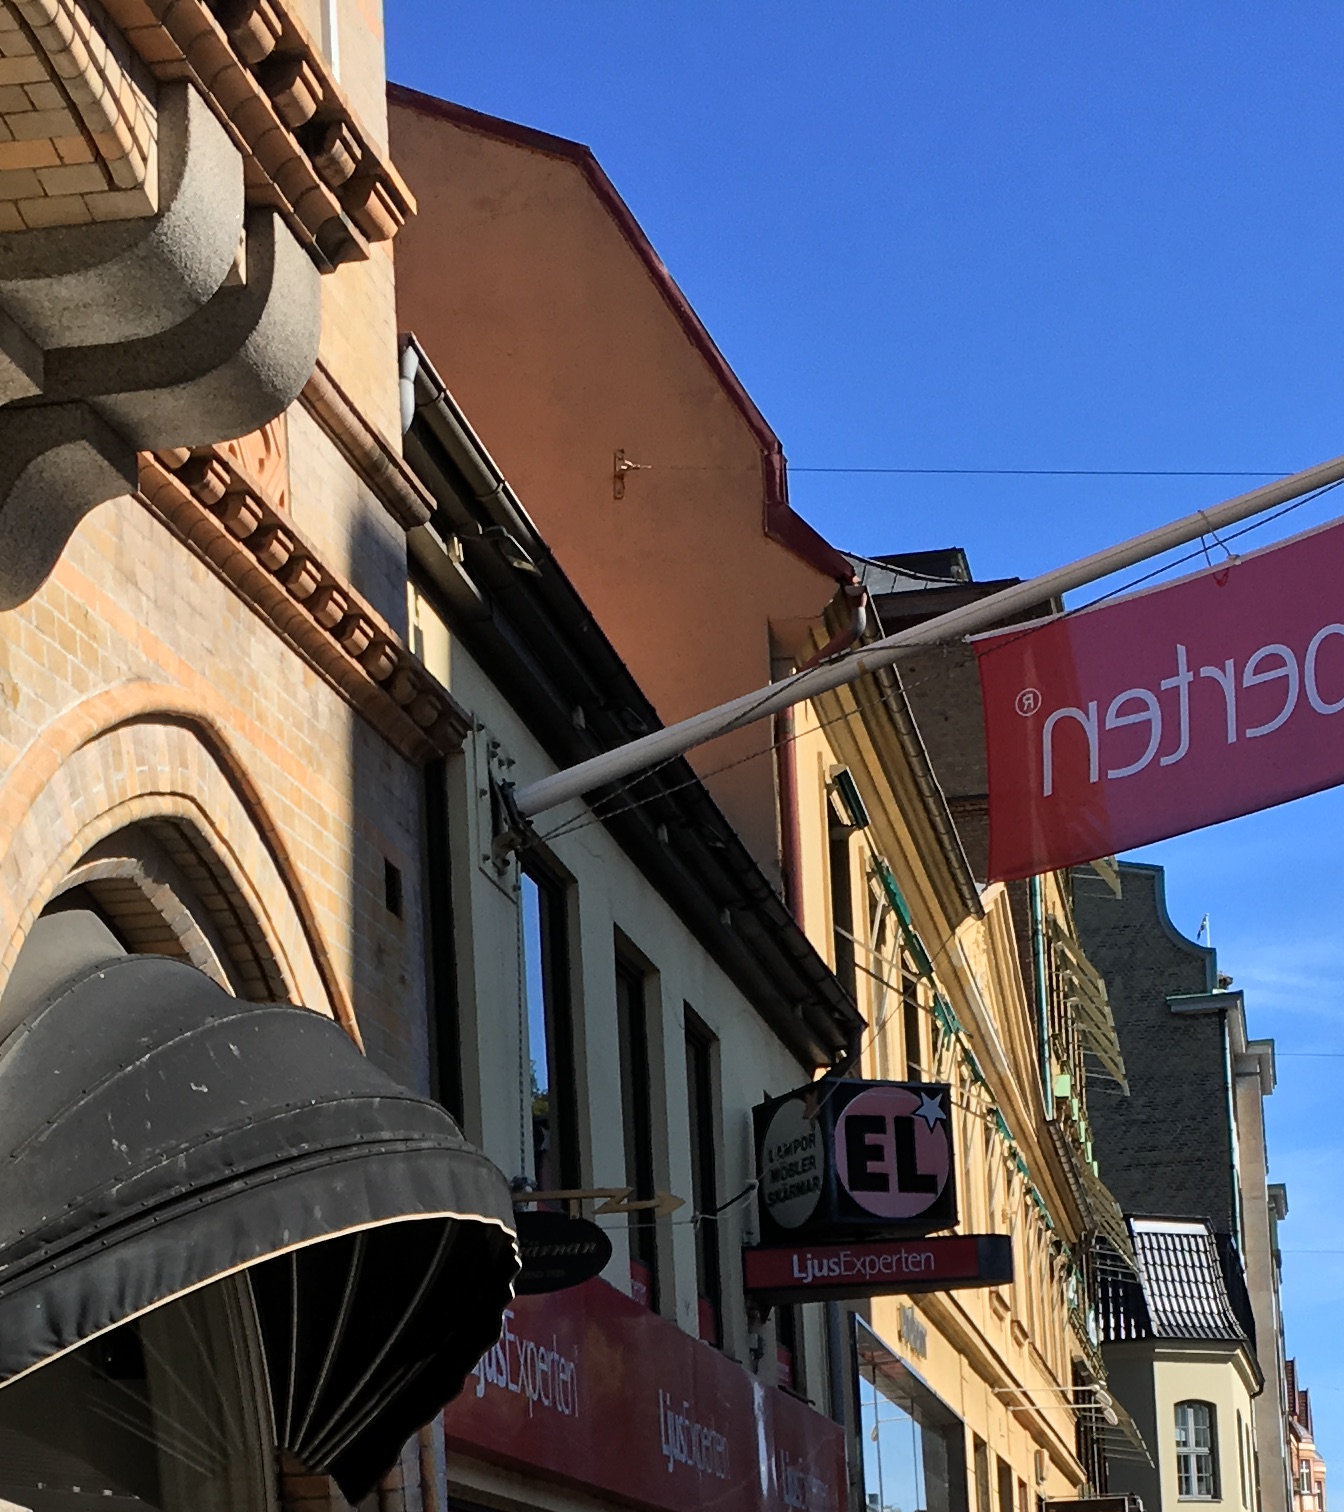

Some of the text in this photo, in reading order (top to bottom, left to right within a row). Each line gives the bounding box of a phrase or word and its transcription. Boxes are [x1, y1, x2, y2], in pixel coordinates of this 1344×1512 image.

[768, 1132, 816, 1164] LAMPOR
[845, 1114, 939, 1195] EL
[769, 1154, 817, 1184] MÖBLER
[766, 1175, 821, 1207] SKÄRMAR
[792, 1250, 935, 1283] LjusExperten
[470, 1309, 579, 1418] jusExperten
